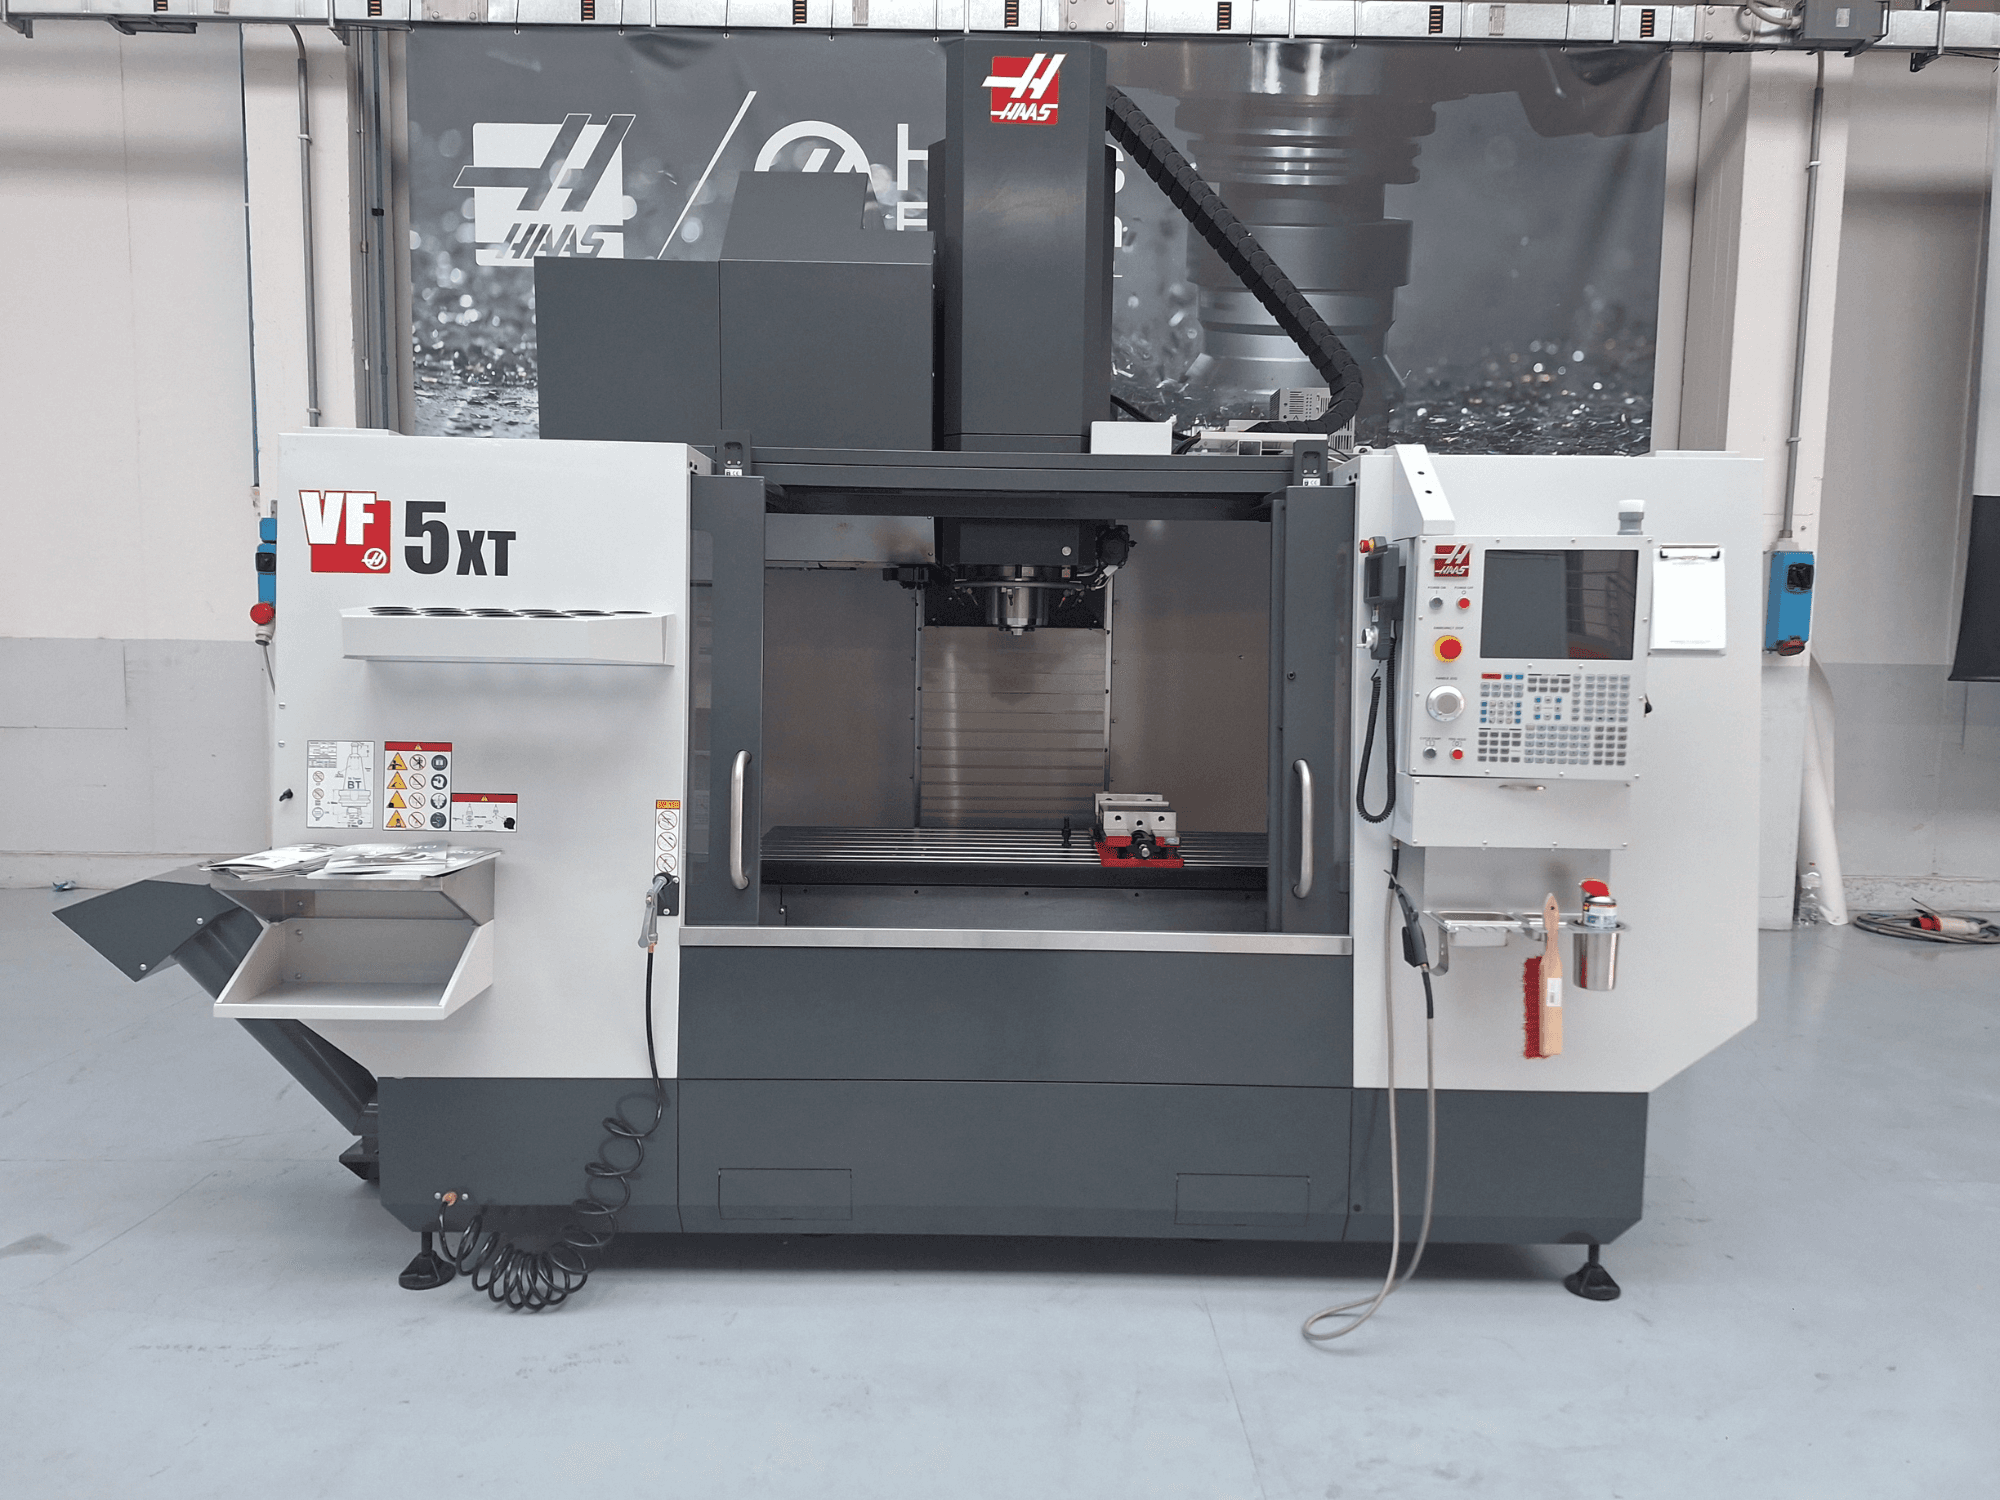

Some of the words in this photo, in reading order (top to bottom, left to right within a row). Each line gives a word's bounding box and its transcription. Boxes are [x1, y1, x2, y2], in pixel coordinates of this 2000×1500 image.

[990, 102, 1058, 121] HAAS
[476, 223, 623, 259] HAAS
[299, 490, 377, 545] VF
[1434, 565, 1469, 575] HAAS
[347, 780, 362, 789] BT
